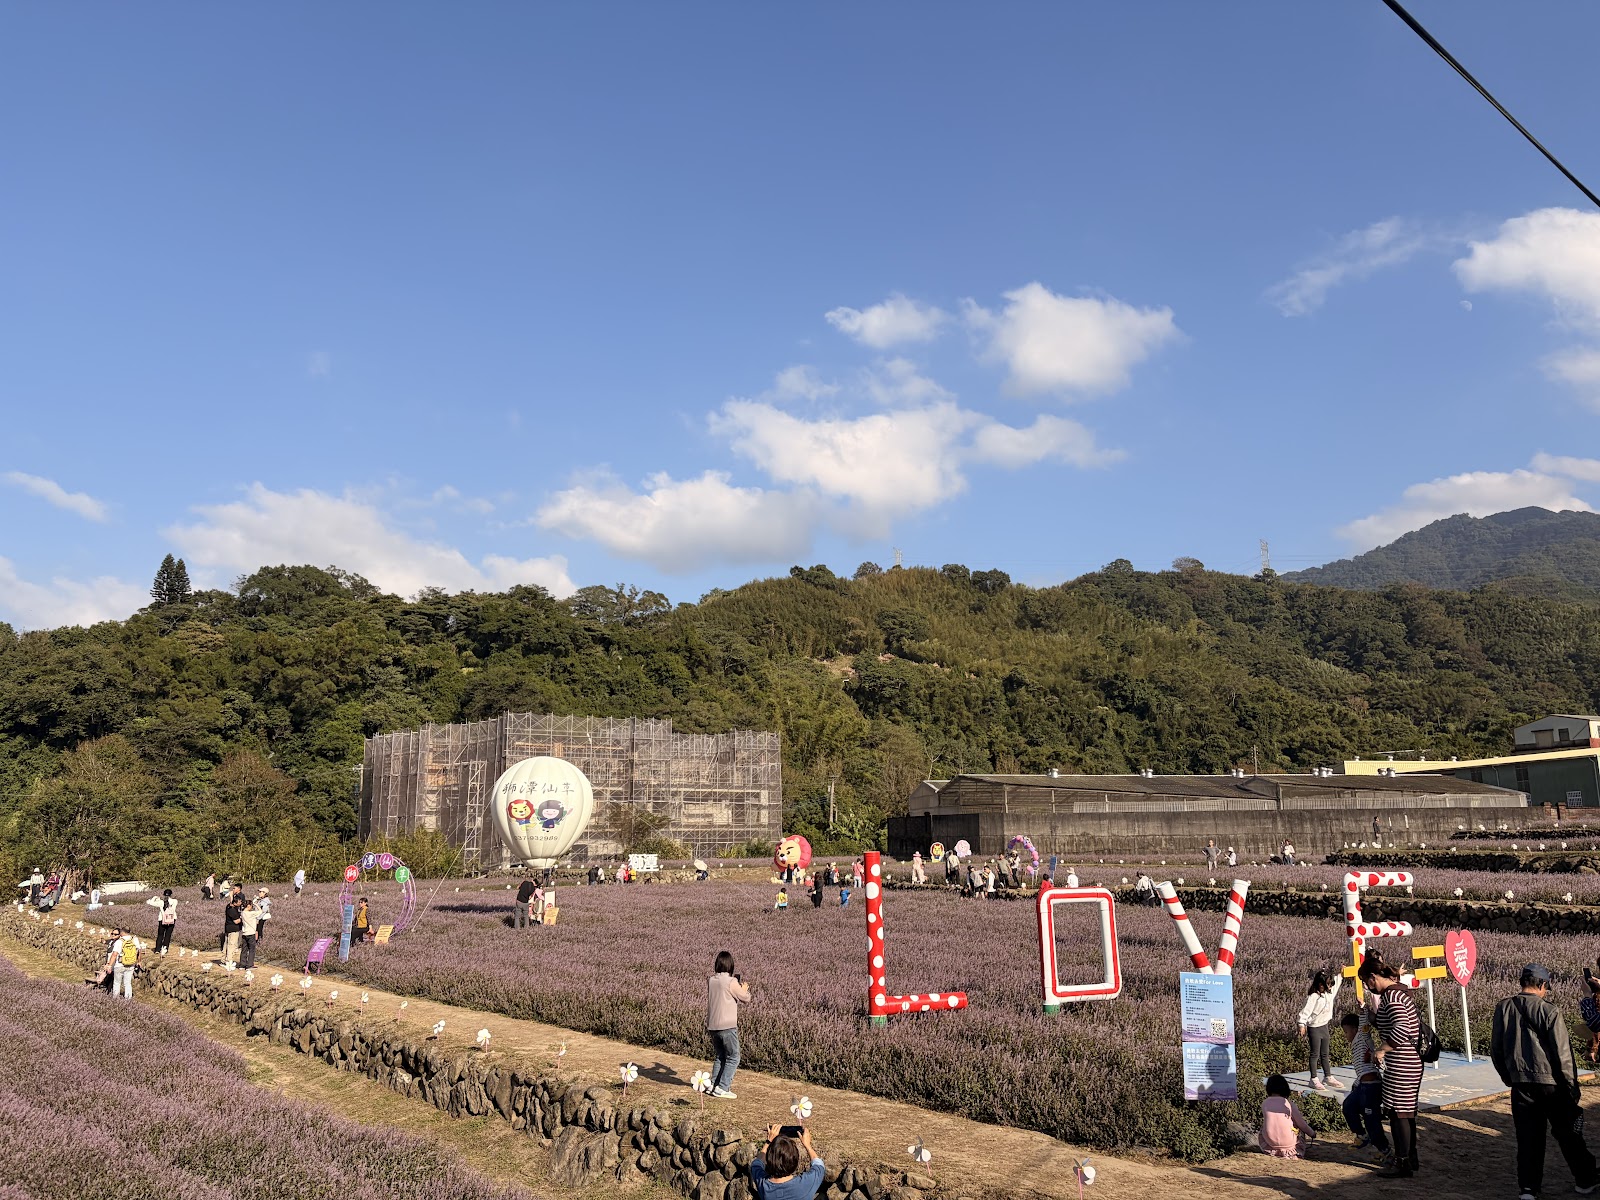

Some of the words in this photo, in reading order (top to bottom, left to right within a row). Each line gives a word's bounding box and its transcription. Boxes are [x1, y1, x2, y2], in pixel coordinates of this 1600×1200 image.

[502, 781, 575, 795] 獅潭仙草
[1453, 938, 1470, 980] 愛
